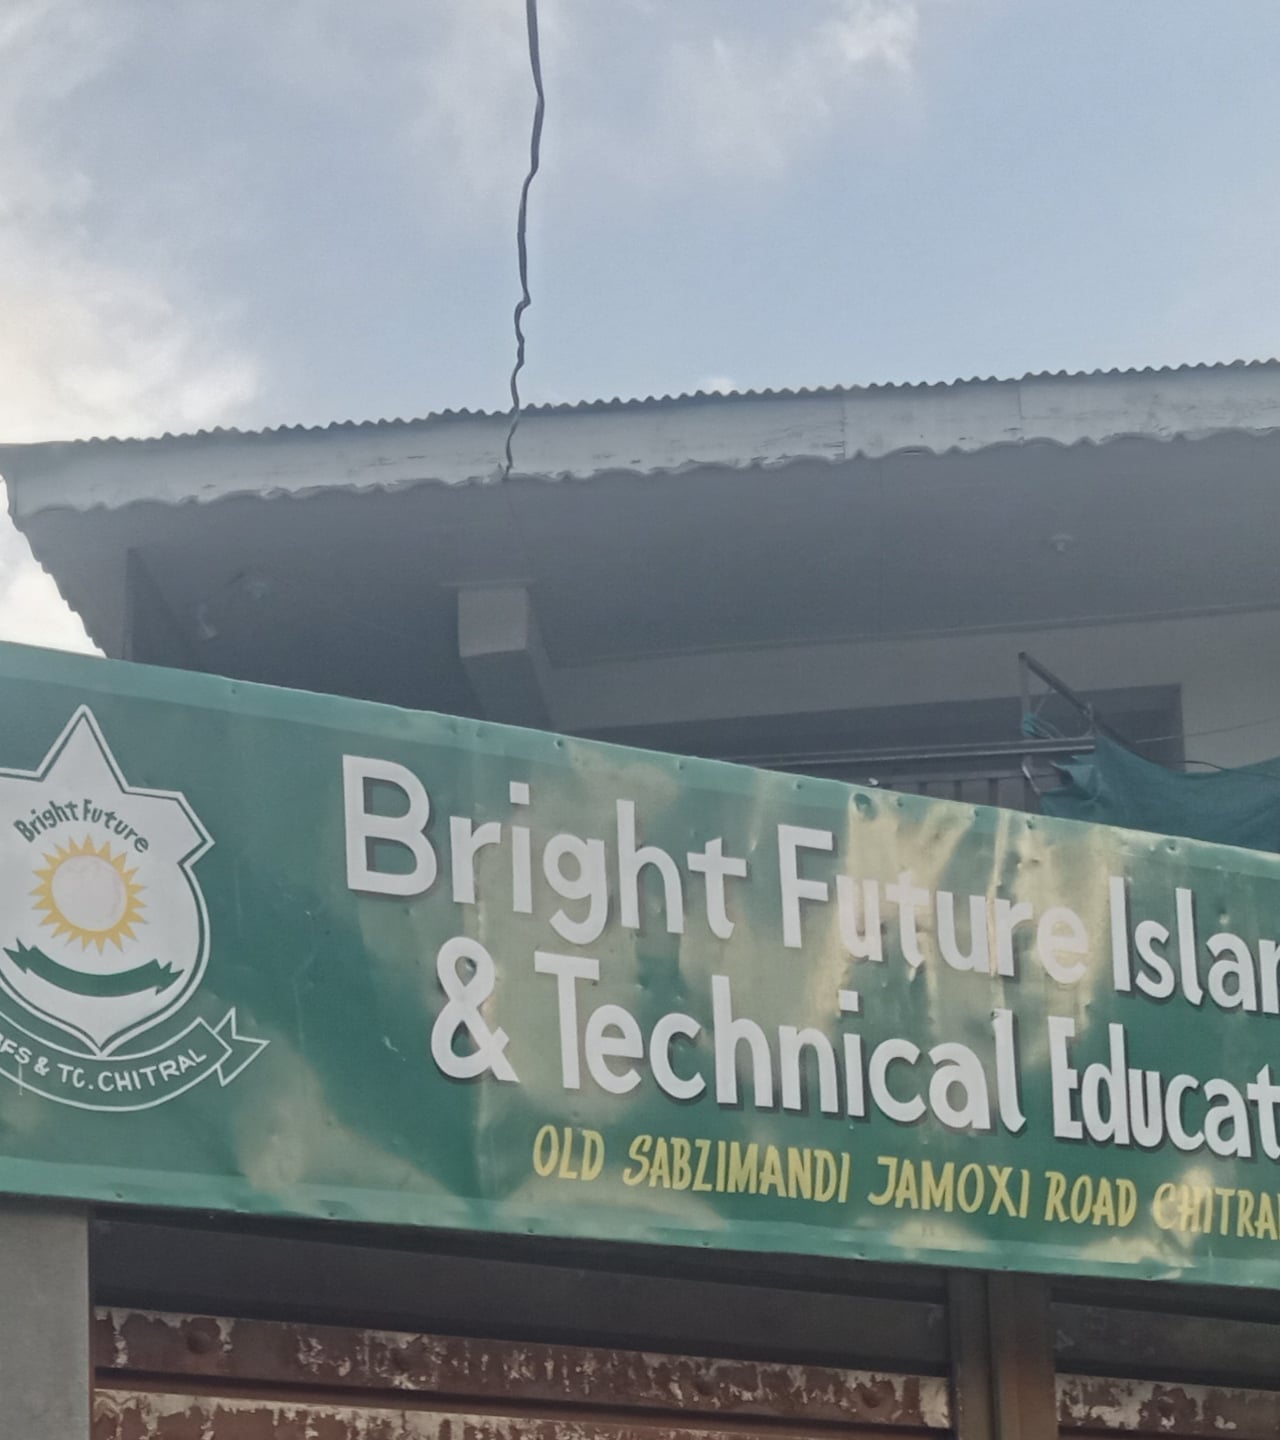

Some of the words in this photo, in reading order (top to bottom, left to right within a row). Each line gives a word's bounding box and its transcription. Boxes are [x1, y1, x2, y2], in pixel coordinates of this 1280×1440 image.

[13, 800, 79, 843] Bright
[83, 798, 150, 853] Future
[342, 755, 748, 945] Bright
[778, 824, 1090, 985] Future
[33, 1056, 51, 1077] &
[431, 936, 520, 1082] &
[535, 951, 1027, 1133] Technical
[533, 1124, 605, 1182] OLD
[623, 1134, 851, 1204] SABZIMANDI
[867, 1155, 1031, 1219] JAMOXI
[1044, 1170, 1137, 1228] ROAD
